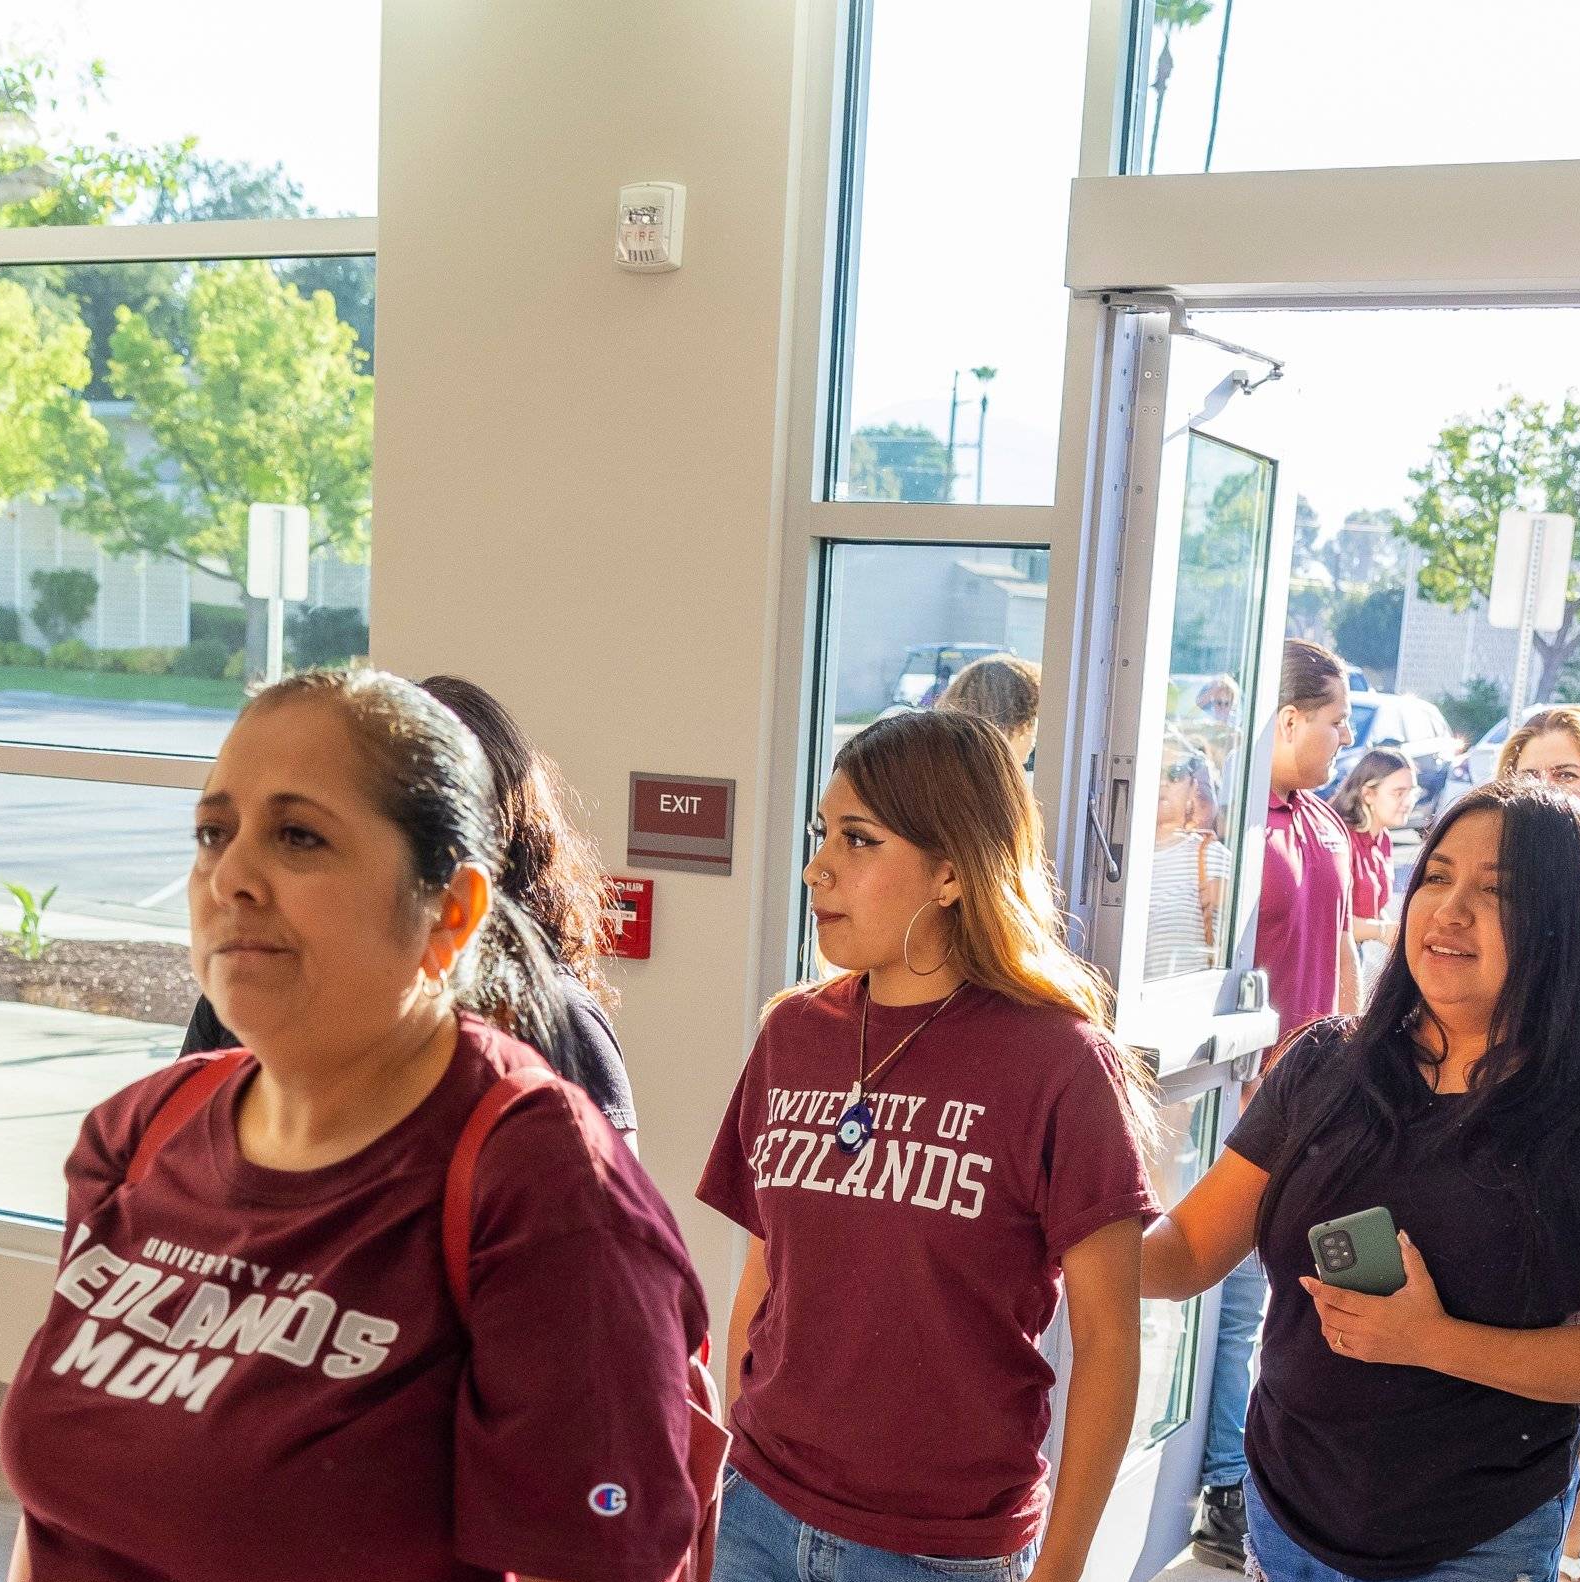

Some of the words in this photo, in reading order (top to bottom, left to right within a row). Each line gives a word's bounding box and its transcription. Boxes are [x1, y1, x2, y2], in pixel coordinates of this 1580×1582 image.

[624, 230, 656, 242] FIRE
[659, 793, 702, 815] EXIT
[937, 1099, 986, 1142] OF
[140, 1236, 271, 1288] UNIVERITY
[276, 1271, 314, 1293] OF
[54, 1222, 400, 1380] EDLANDS
[51, 1319, 236, 1414] MOM
